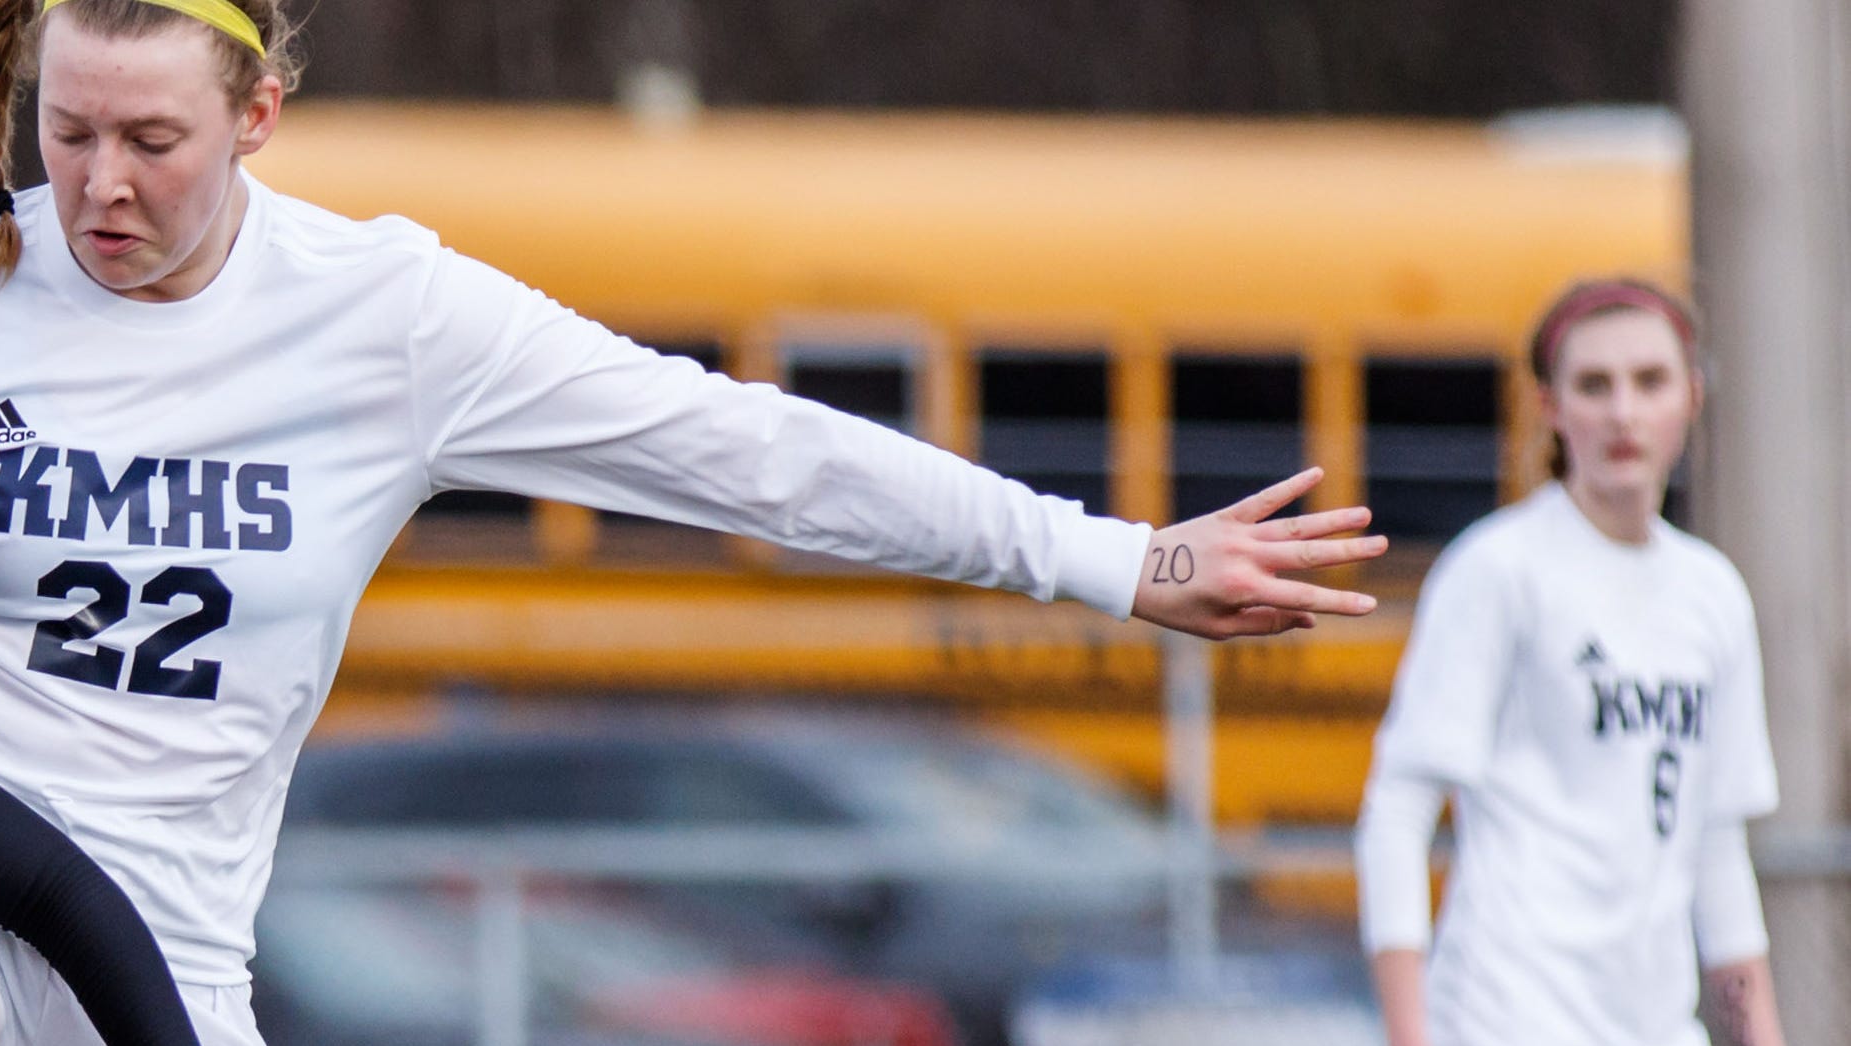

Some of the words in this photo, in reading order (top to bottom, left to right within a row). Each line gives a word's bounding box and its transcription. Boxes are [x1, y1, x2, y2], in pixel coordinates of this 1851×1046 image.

[1152, 543, 1195, 584] 20
[27, 560, 233, 700] 22
[1591, 679, 1706, 738] KMH
